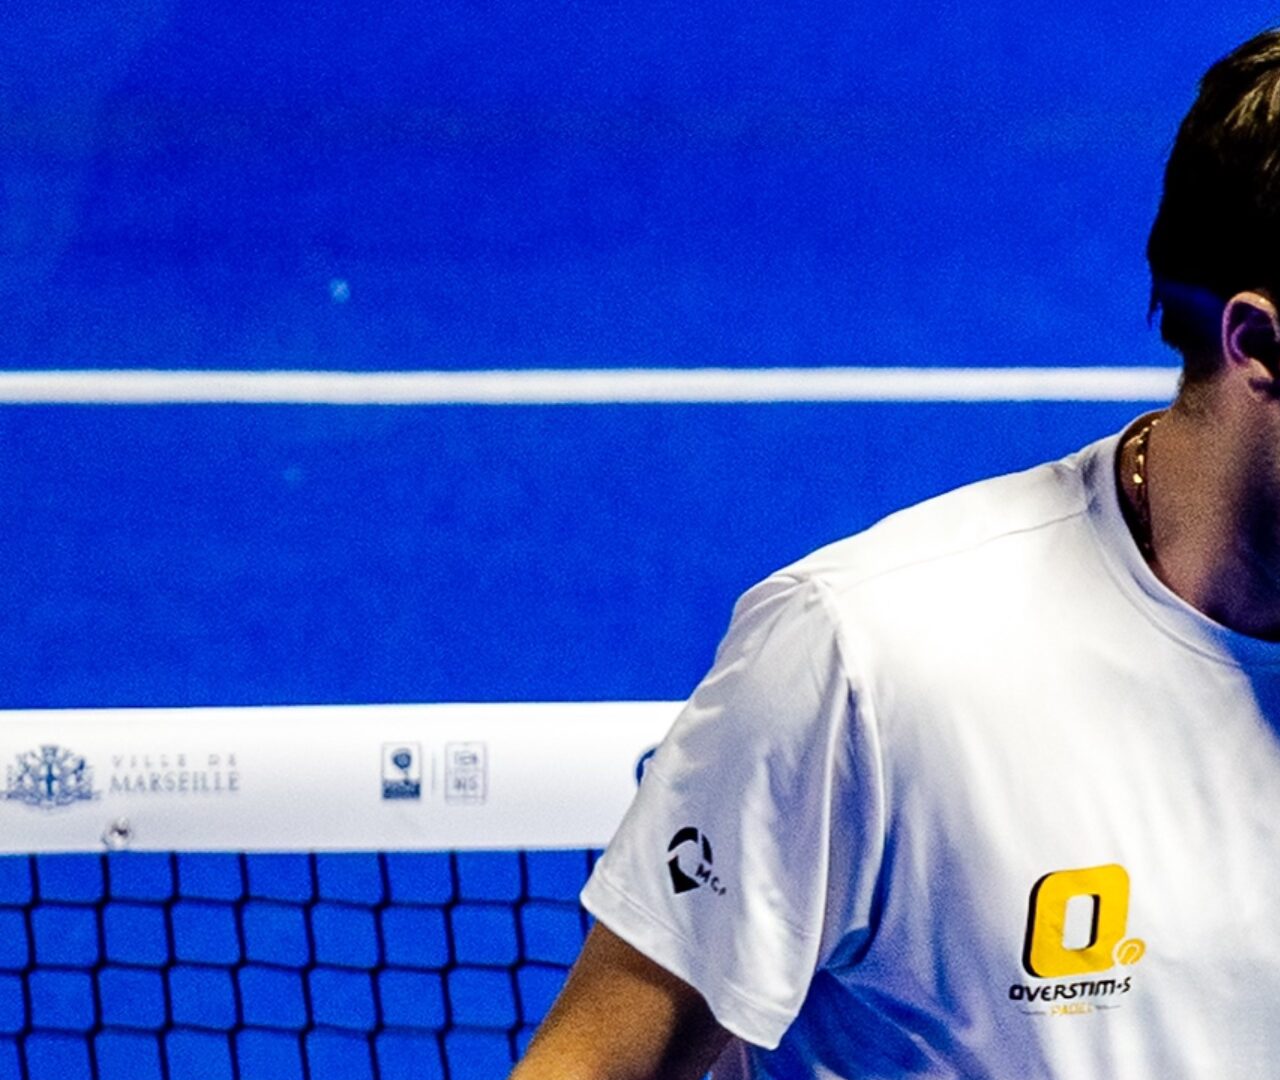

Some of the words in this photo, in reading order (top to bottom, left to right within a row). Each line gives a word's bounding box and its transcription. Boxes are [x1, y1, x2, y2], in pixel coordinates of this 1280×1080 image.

[111, 753, 188, 769] VILLE
[207, 753, 237, 768] DE
[108, 770, 241, 793] MARSEILLE
